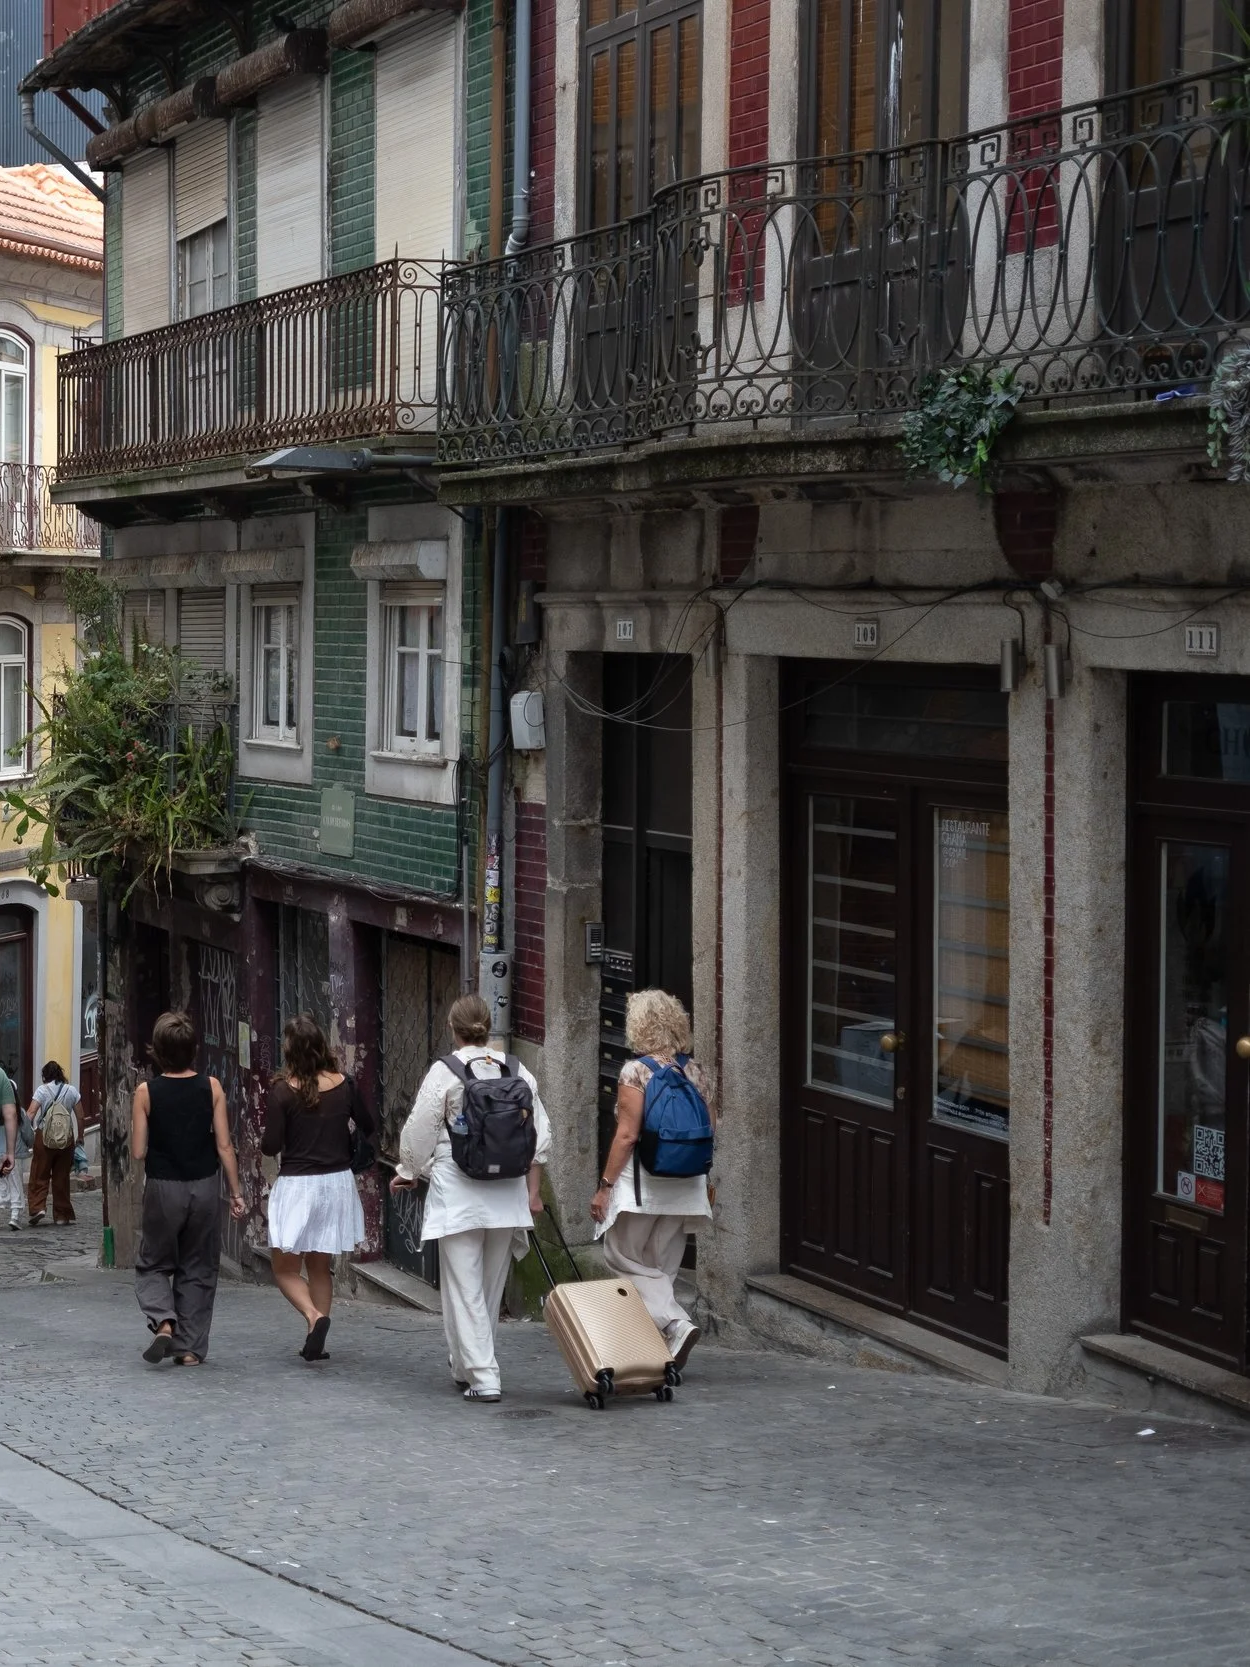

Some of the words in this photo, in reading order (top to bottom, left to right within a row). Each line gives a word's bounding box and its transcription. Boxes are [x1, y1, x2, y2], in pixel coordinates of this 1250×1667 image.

[618, 623, 632, 637] 107
[856, 626, 875, 642] 109
[1188, 630, 1215, 649] 111
[942, 819, 991, 836] RESTAURANTE
